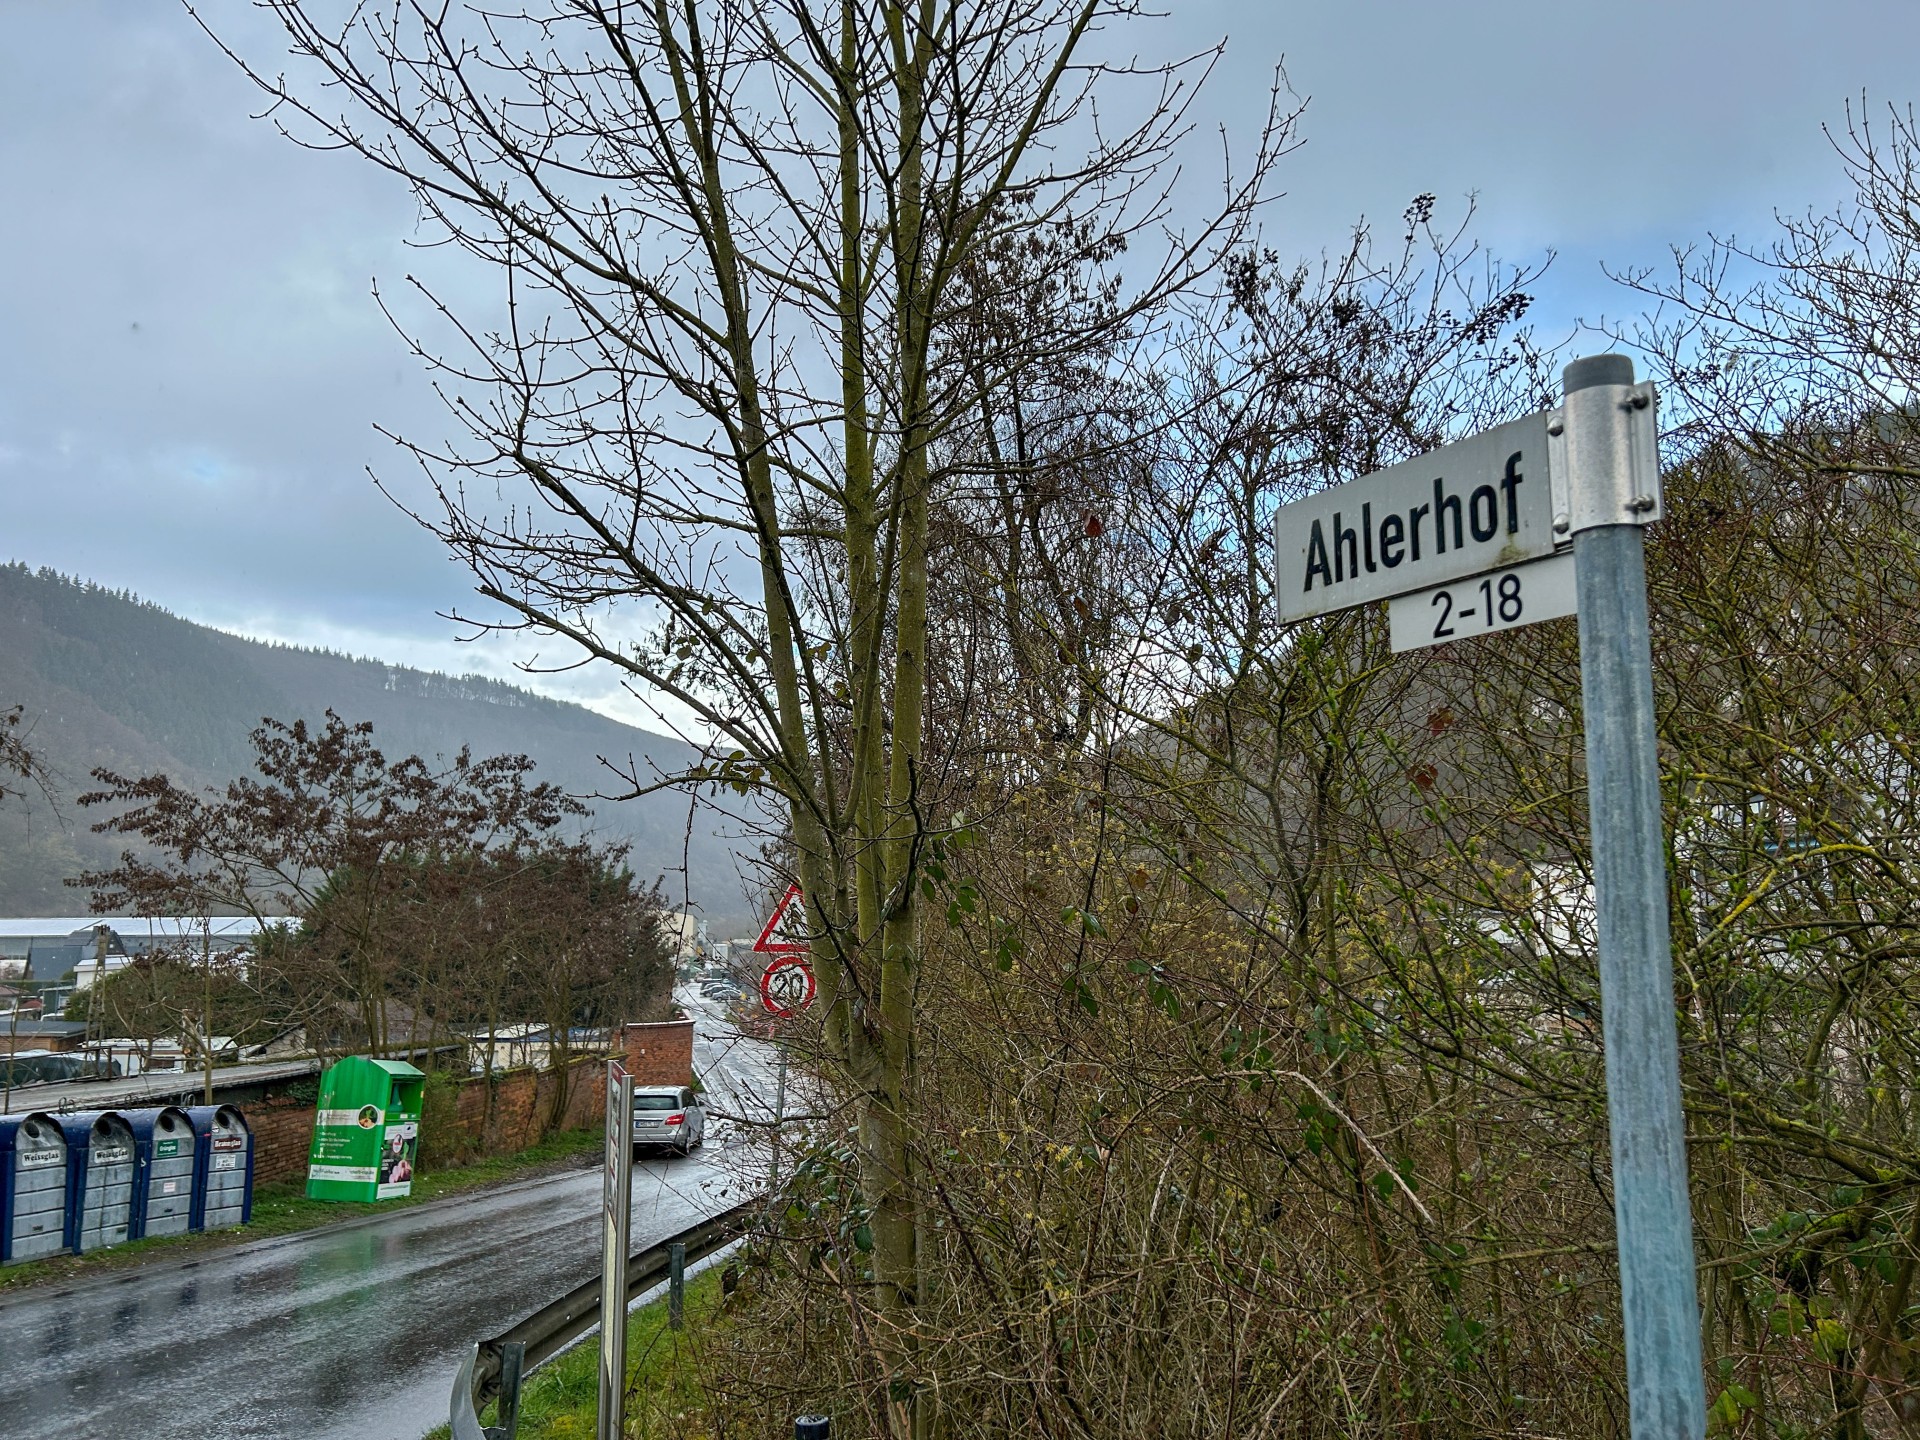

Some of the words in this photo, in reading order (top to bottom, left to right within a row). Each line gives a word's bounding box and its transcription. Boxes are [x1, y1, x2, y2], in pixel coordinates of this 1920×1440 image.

[1304, 450, 1523, 592] Ahlerhof
[1431, 573, 1523, 639] 2-18
[774, 973, 804, 1001] 20
[24, 1152, 59, 1162] Weissglas
[97, 1149, 128, 1160] Weissglas
